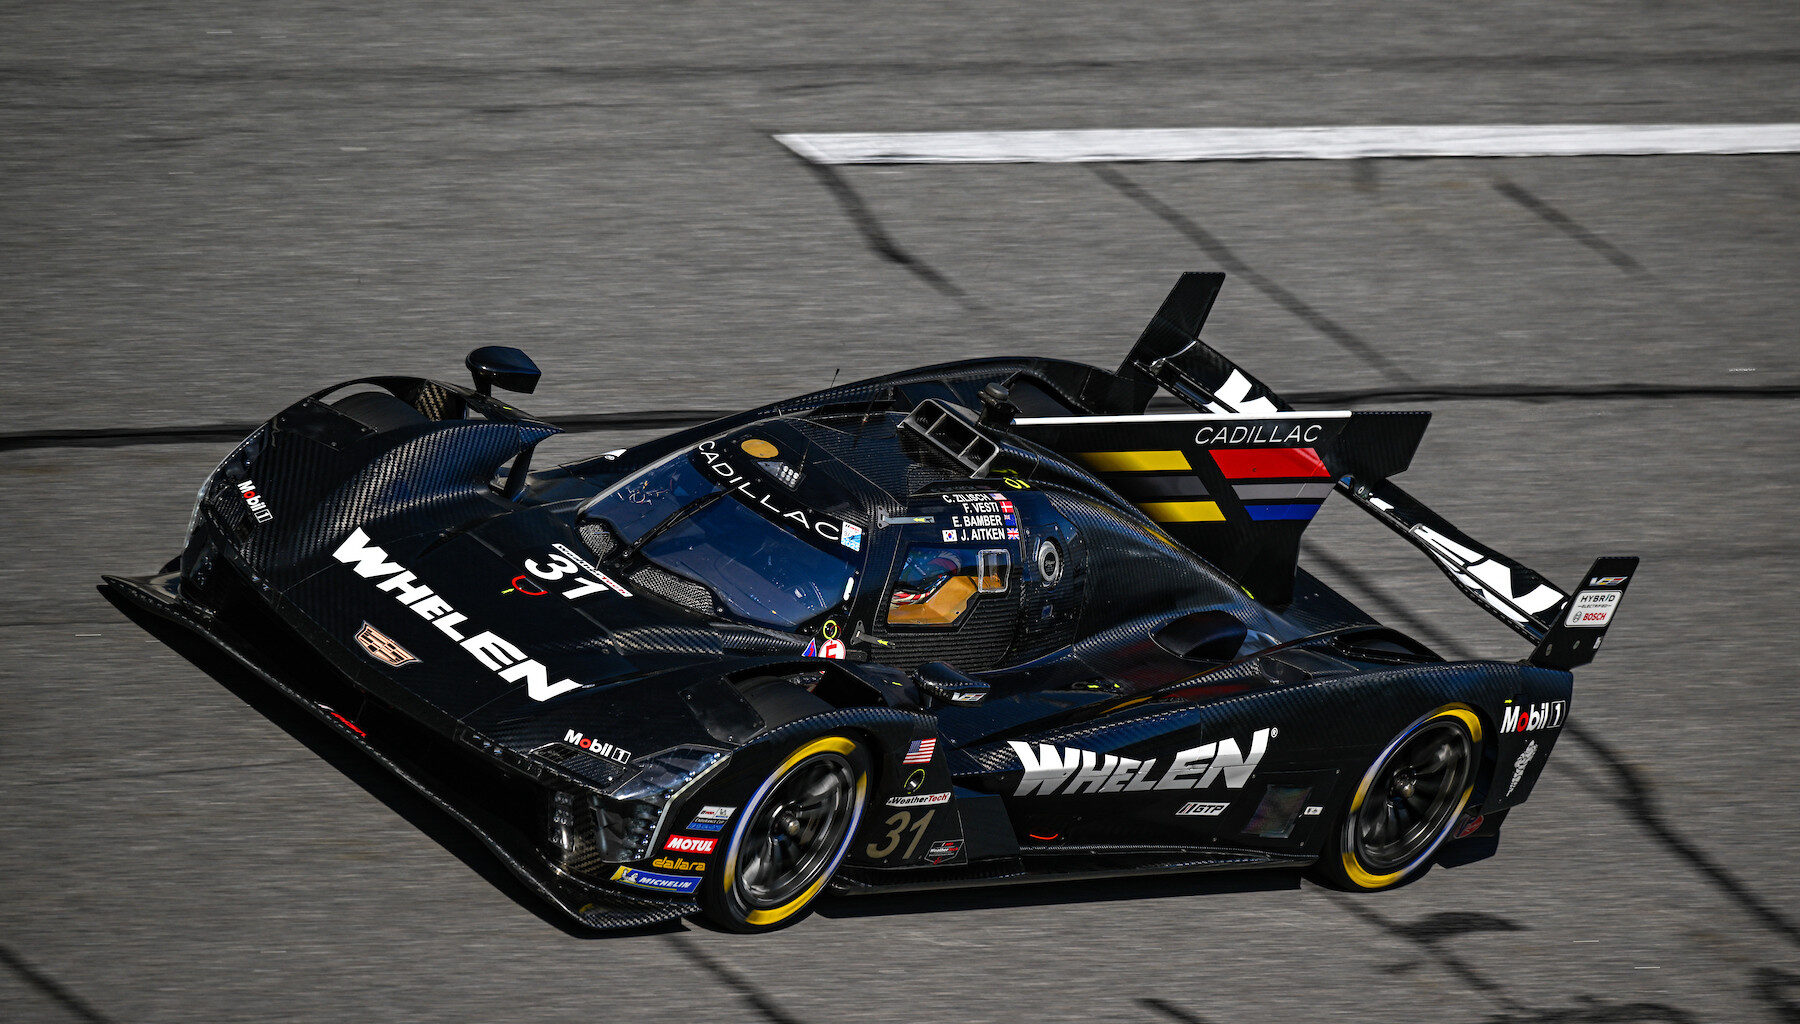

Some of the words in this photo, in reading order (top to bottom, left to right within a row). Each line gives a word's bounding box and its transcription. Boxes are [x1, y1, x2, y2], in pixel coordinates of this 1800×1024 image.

[1194, 424, 1323, 444] CADILLAC
[237, 480, 267, 512] Mobil
[698, 440, 840, 541] CADILLAC
[942, 494, 956, 503] C.
[962, 502, 973, 514] F.
[972, 501, 1000, 513] VESTI
[952, 516, 963, 528] E.
[963, 514, 1003, 527] BAMBER
[961, 529, 970, 542] J.
[971, 528, 1006, 541] AITKEN
[524, 553, 610, 600] 31
[1580, 594, 1616, 603] HYBRID
[331, 526, 584, 702] WHELEN
[1582, 612, 1607, 621] BOSCH
[1500, 702, 1550, 733] Mobil
[563, 729, 614, 757] Mobil
[887, 792, 948, 805] WeatherTech
[1192, 803, 1226, 814] GTP
[866, 809, 936, 860] 31
[667, 837, 714, 852] MOTUL
[652, 856, 706, 871] dallara
[638, 876, 693, 889] MICHELIN
